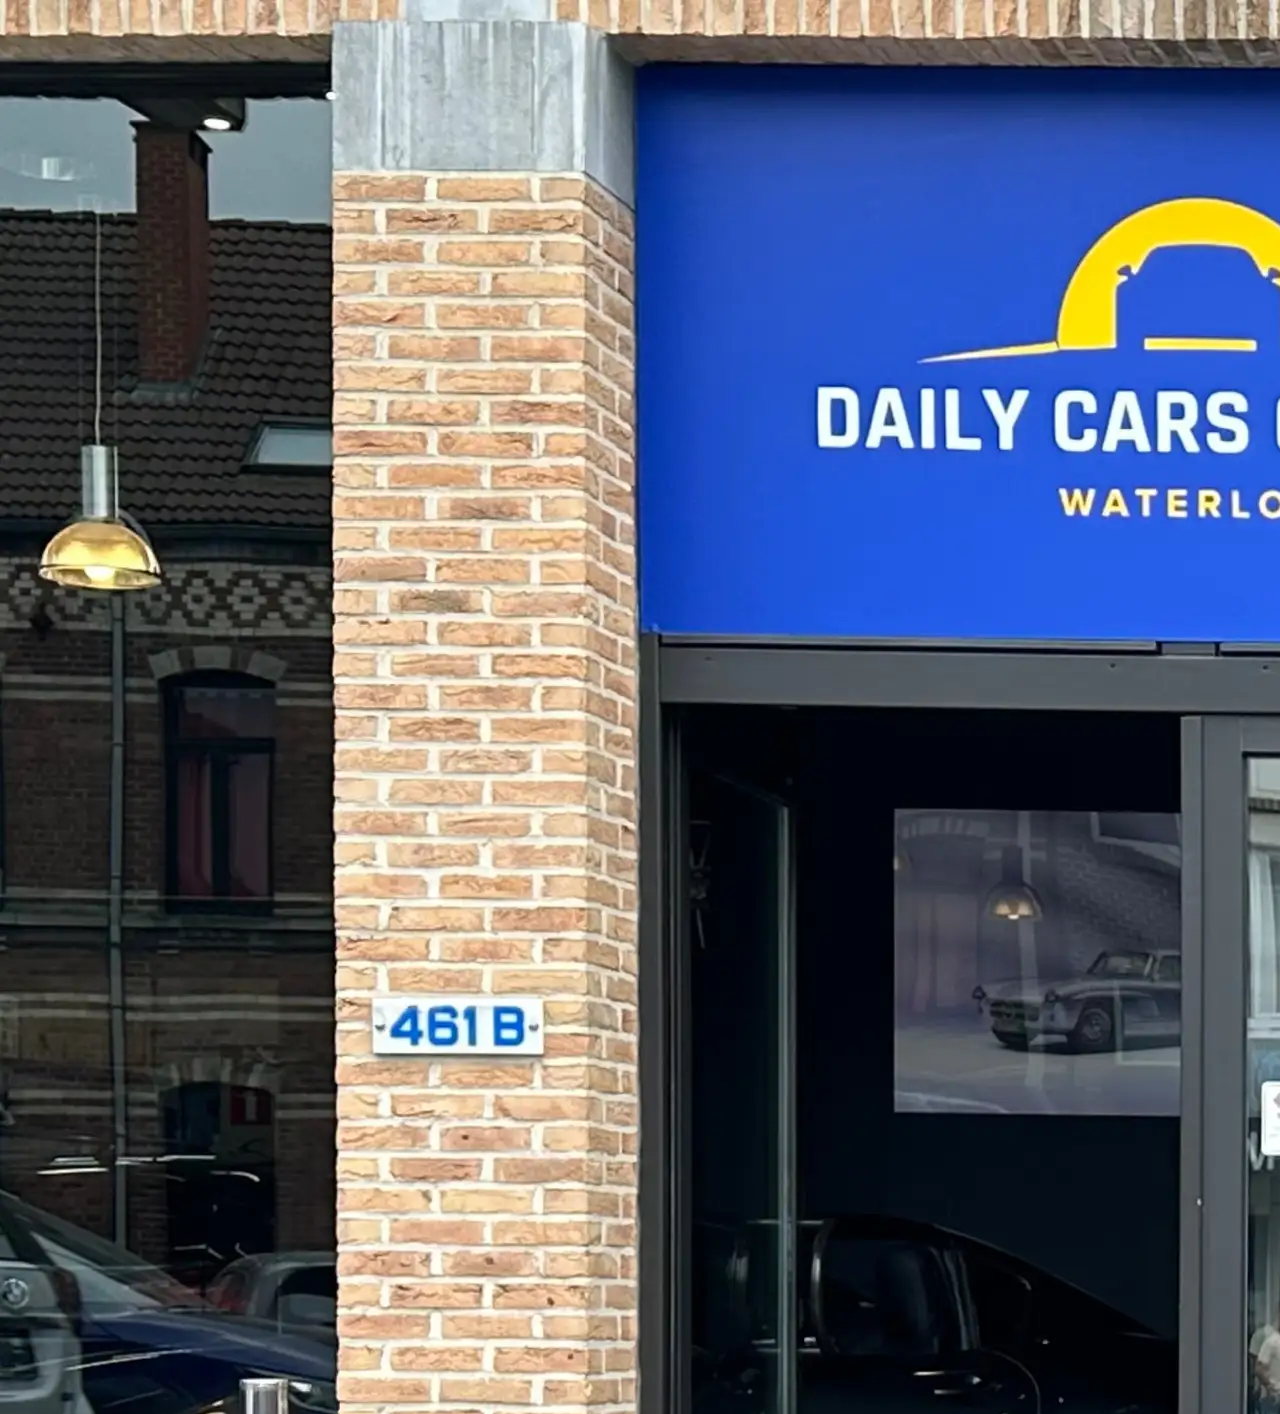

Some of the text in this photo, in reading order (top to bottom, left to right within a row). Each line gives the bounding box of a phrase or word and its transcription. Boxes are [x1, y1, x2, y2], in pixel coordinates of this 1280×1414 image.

[815, 385, 1030, 451] DAILY
[1053, 389, 1250, 454] CARS
[390, 1004, 525, 1047] 461 B
